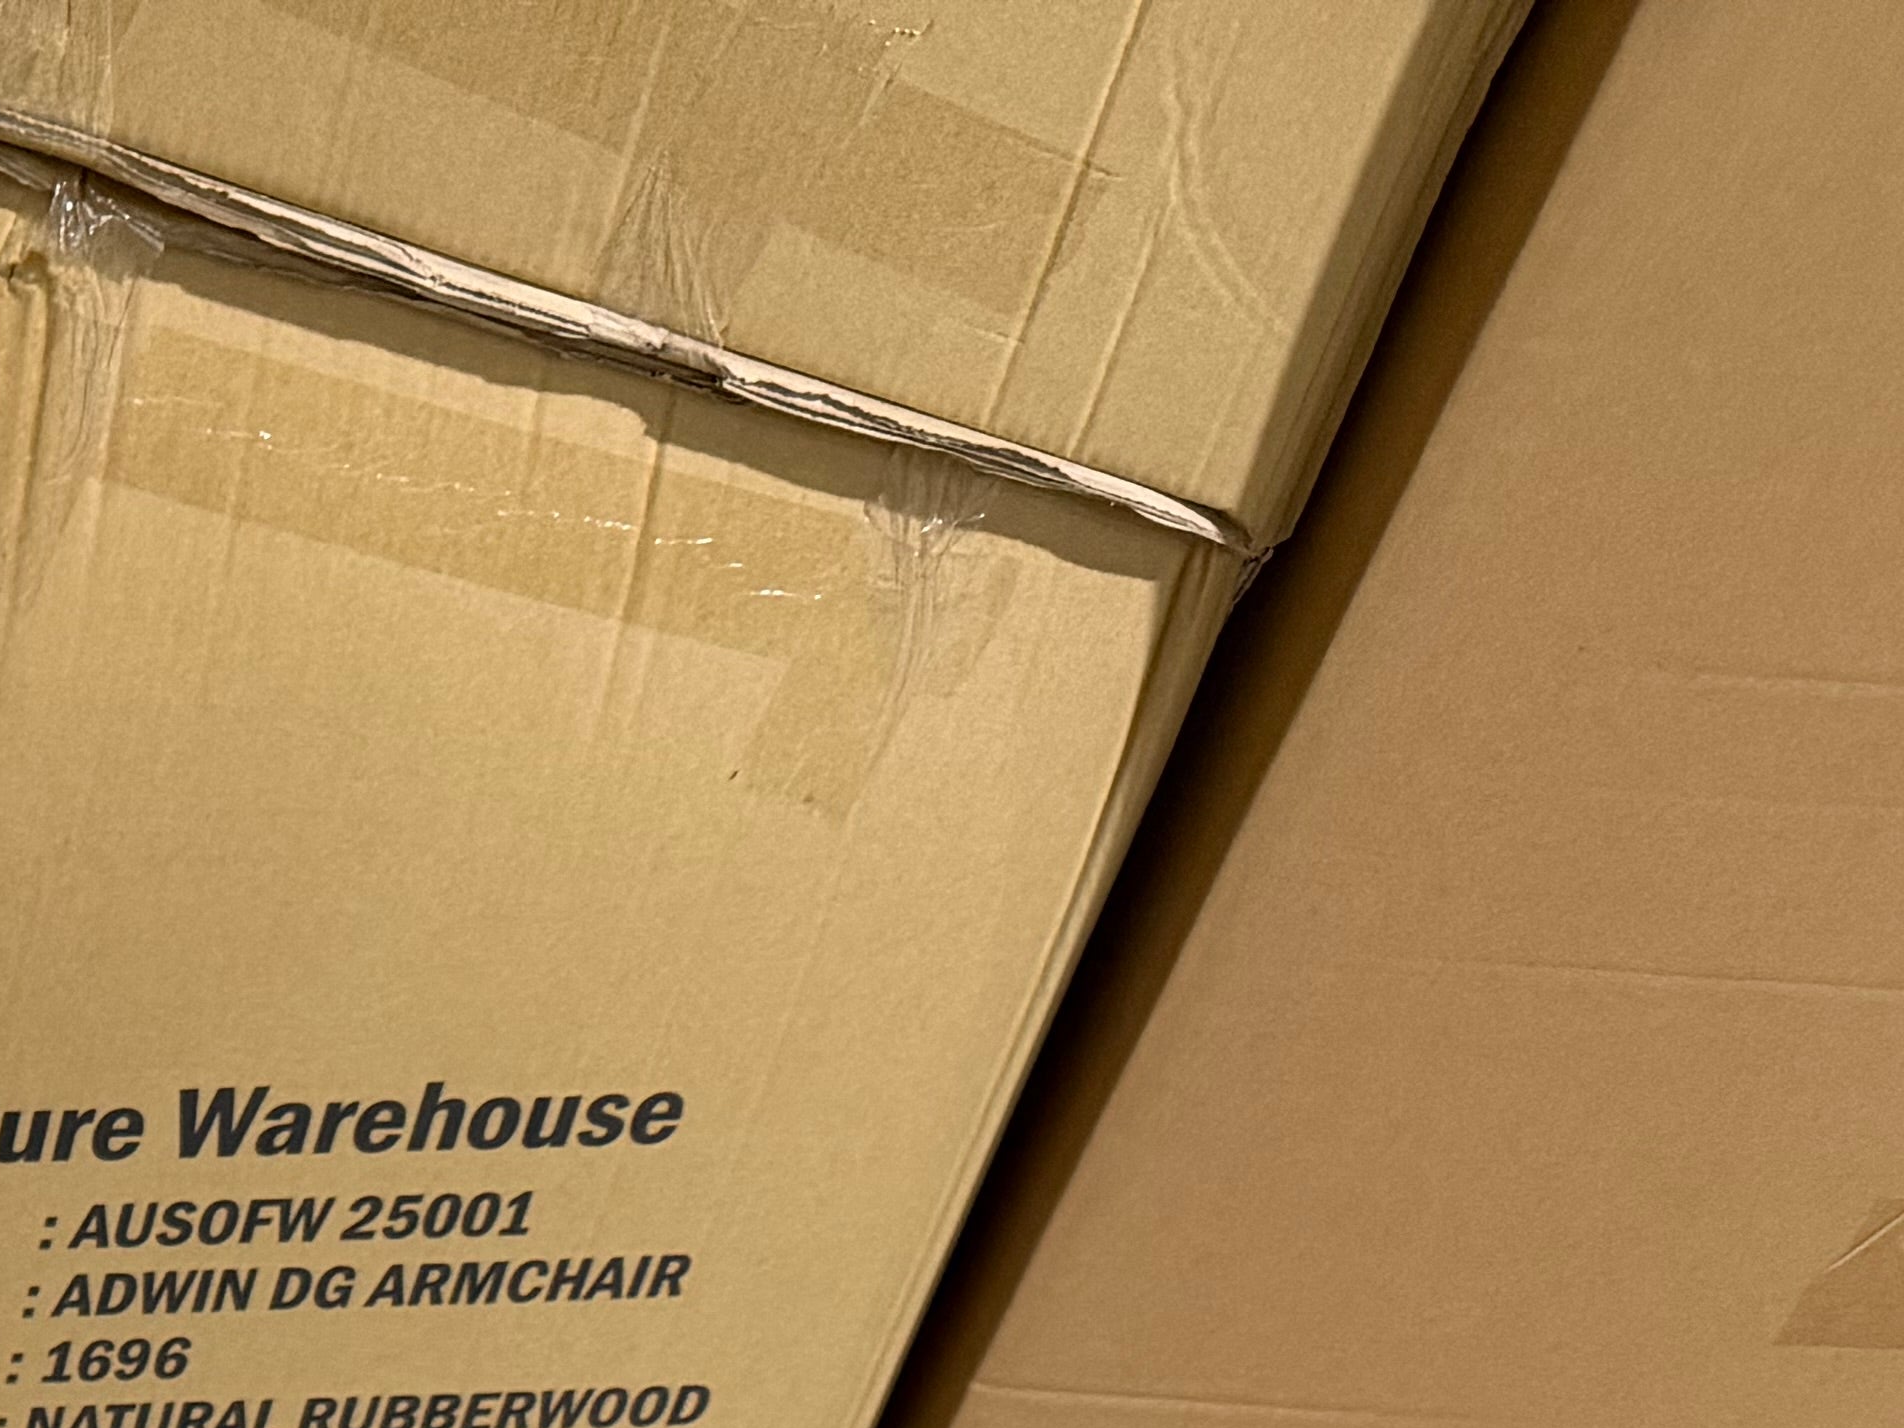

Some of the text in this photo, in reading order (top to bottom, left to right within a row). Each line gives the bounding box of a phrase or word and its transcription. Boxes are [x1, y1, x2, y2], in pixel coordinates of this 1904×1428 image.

[178, 1080, 685, 1159] Warehouse
[67, 1196, 337, 1250] AUSOFW
[339, 1190, 534, 1241] 25001
[50, 1267, 259, 1318] ADWIN
[268, 1265, 357, 1311] DG
[363, 1254, 692, 1308] ARMCHAIR
[41, 1336, 192, 1383] 1696
